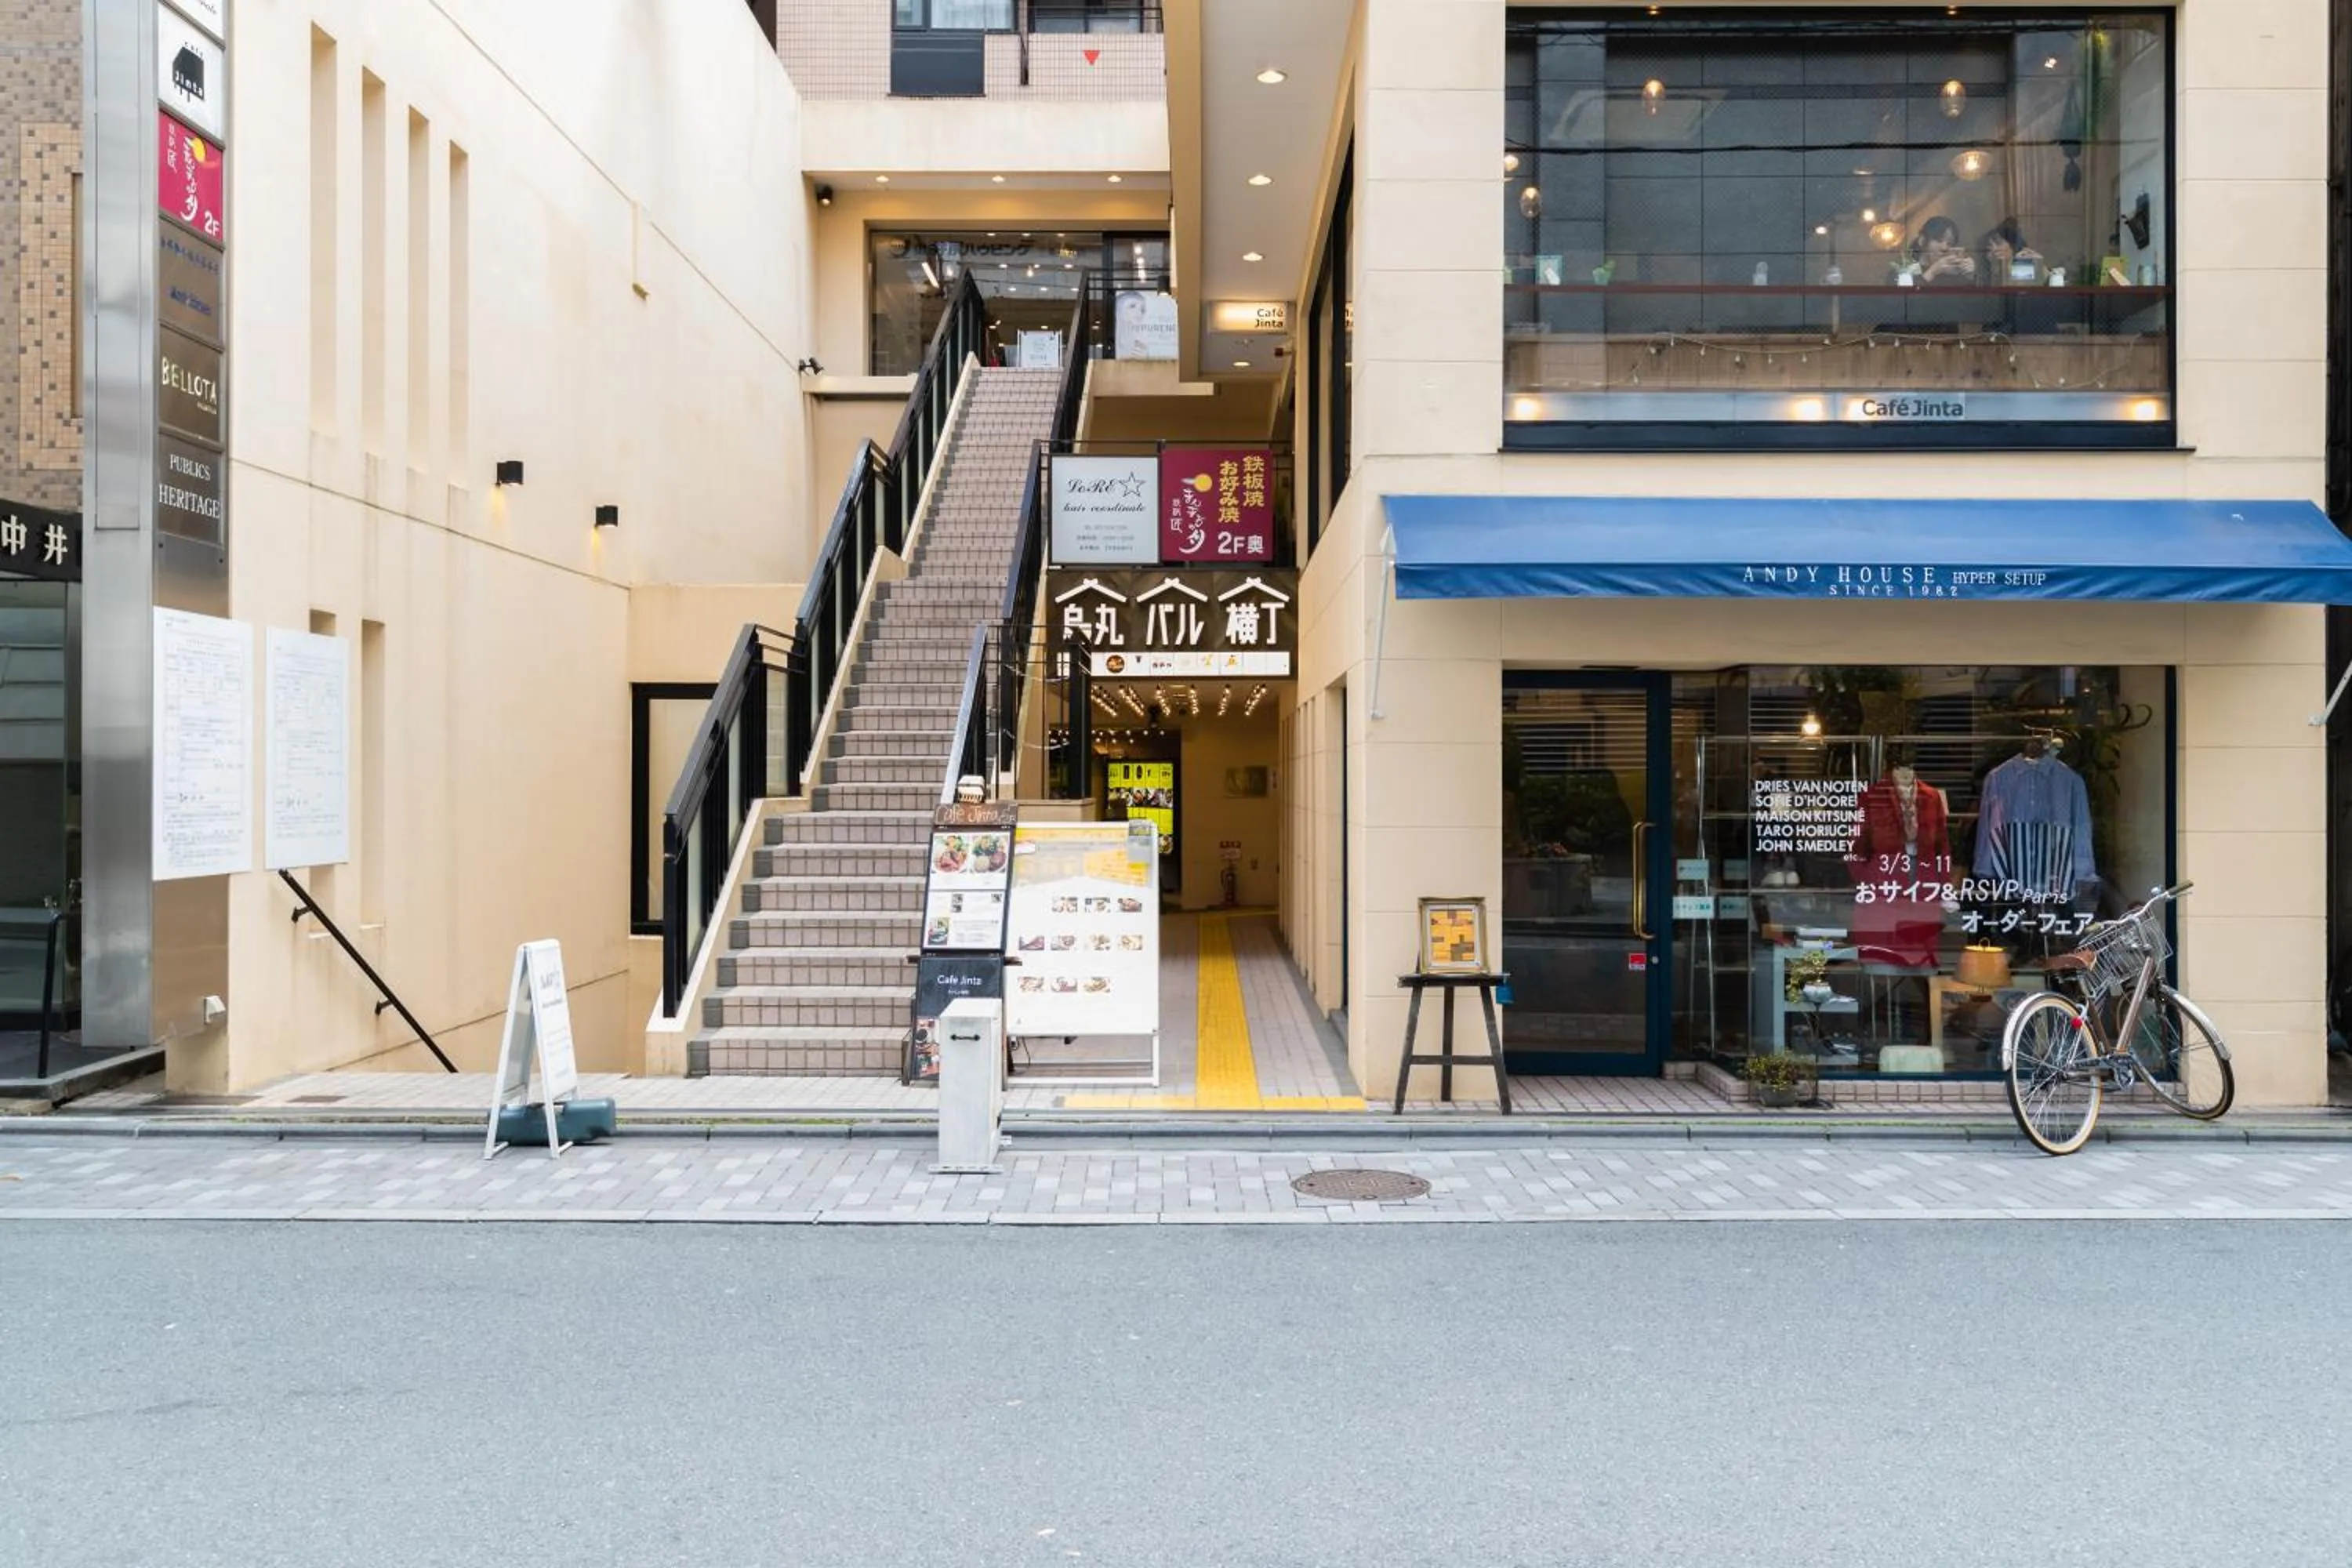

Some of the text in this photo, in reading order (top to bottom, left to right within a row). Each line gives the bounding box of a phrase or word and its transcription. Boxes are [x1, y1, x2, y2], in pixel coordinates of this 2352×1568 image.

[205, 210, 220, 235] 2F
[1254, 319, 1283, 328] Jinta
[162, 357, 217, 405] BELLOTA
[169, 453, 211, 481] PUBLICS
[1218, 461, 1240, 523] お好み焼
[1243, 456, 1265, 507] 鉄板焼
[158, 483, 220, 519] HERITAGE
[2, 514, 68, 564] 中井
[1743, 565, 2046, 586] ANDY HOUSE HYPER SETUP
[1829, 585, 1958, 597] SINCE 1982
[1146, 603, 1205, 645] バル
[1225, 602, 1285, 644] 横丁
[1755, 780, 1868, 793] DRIES VAN NOTEN
[1755, 795, 1855, 807] SOFIE D'HOORE
[1755, 807, 1866, 822] MAISON KITSUNÉ
[1756, 824, 1860, 837] TARO HORIUCHI
[1756, 839, 1856, 851] JOHN SMEDLEY
[2022, 888, 2067, 904] Paris
[1962, 908, 2094, 935] オーダーフェア
